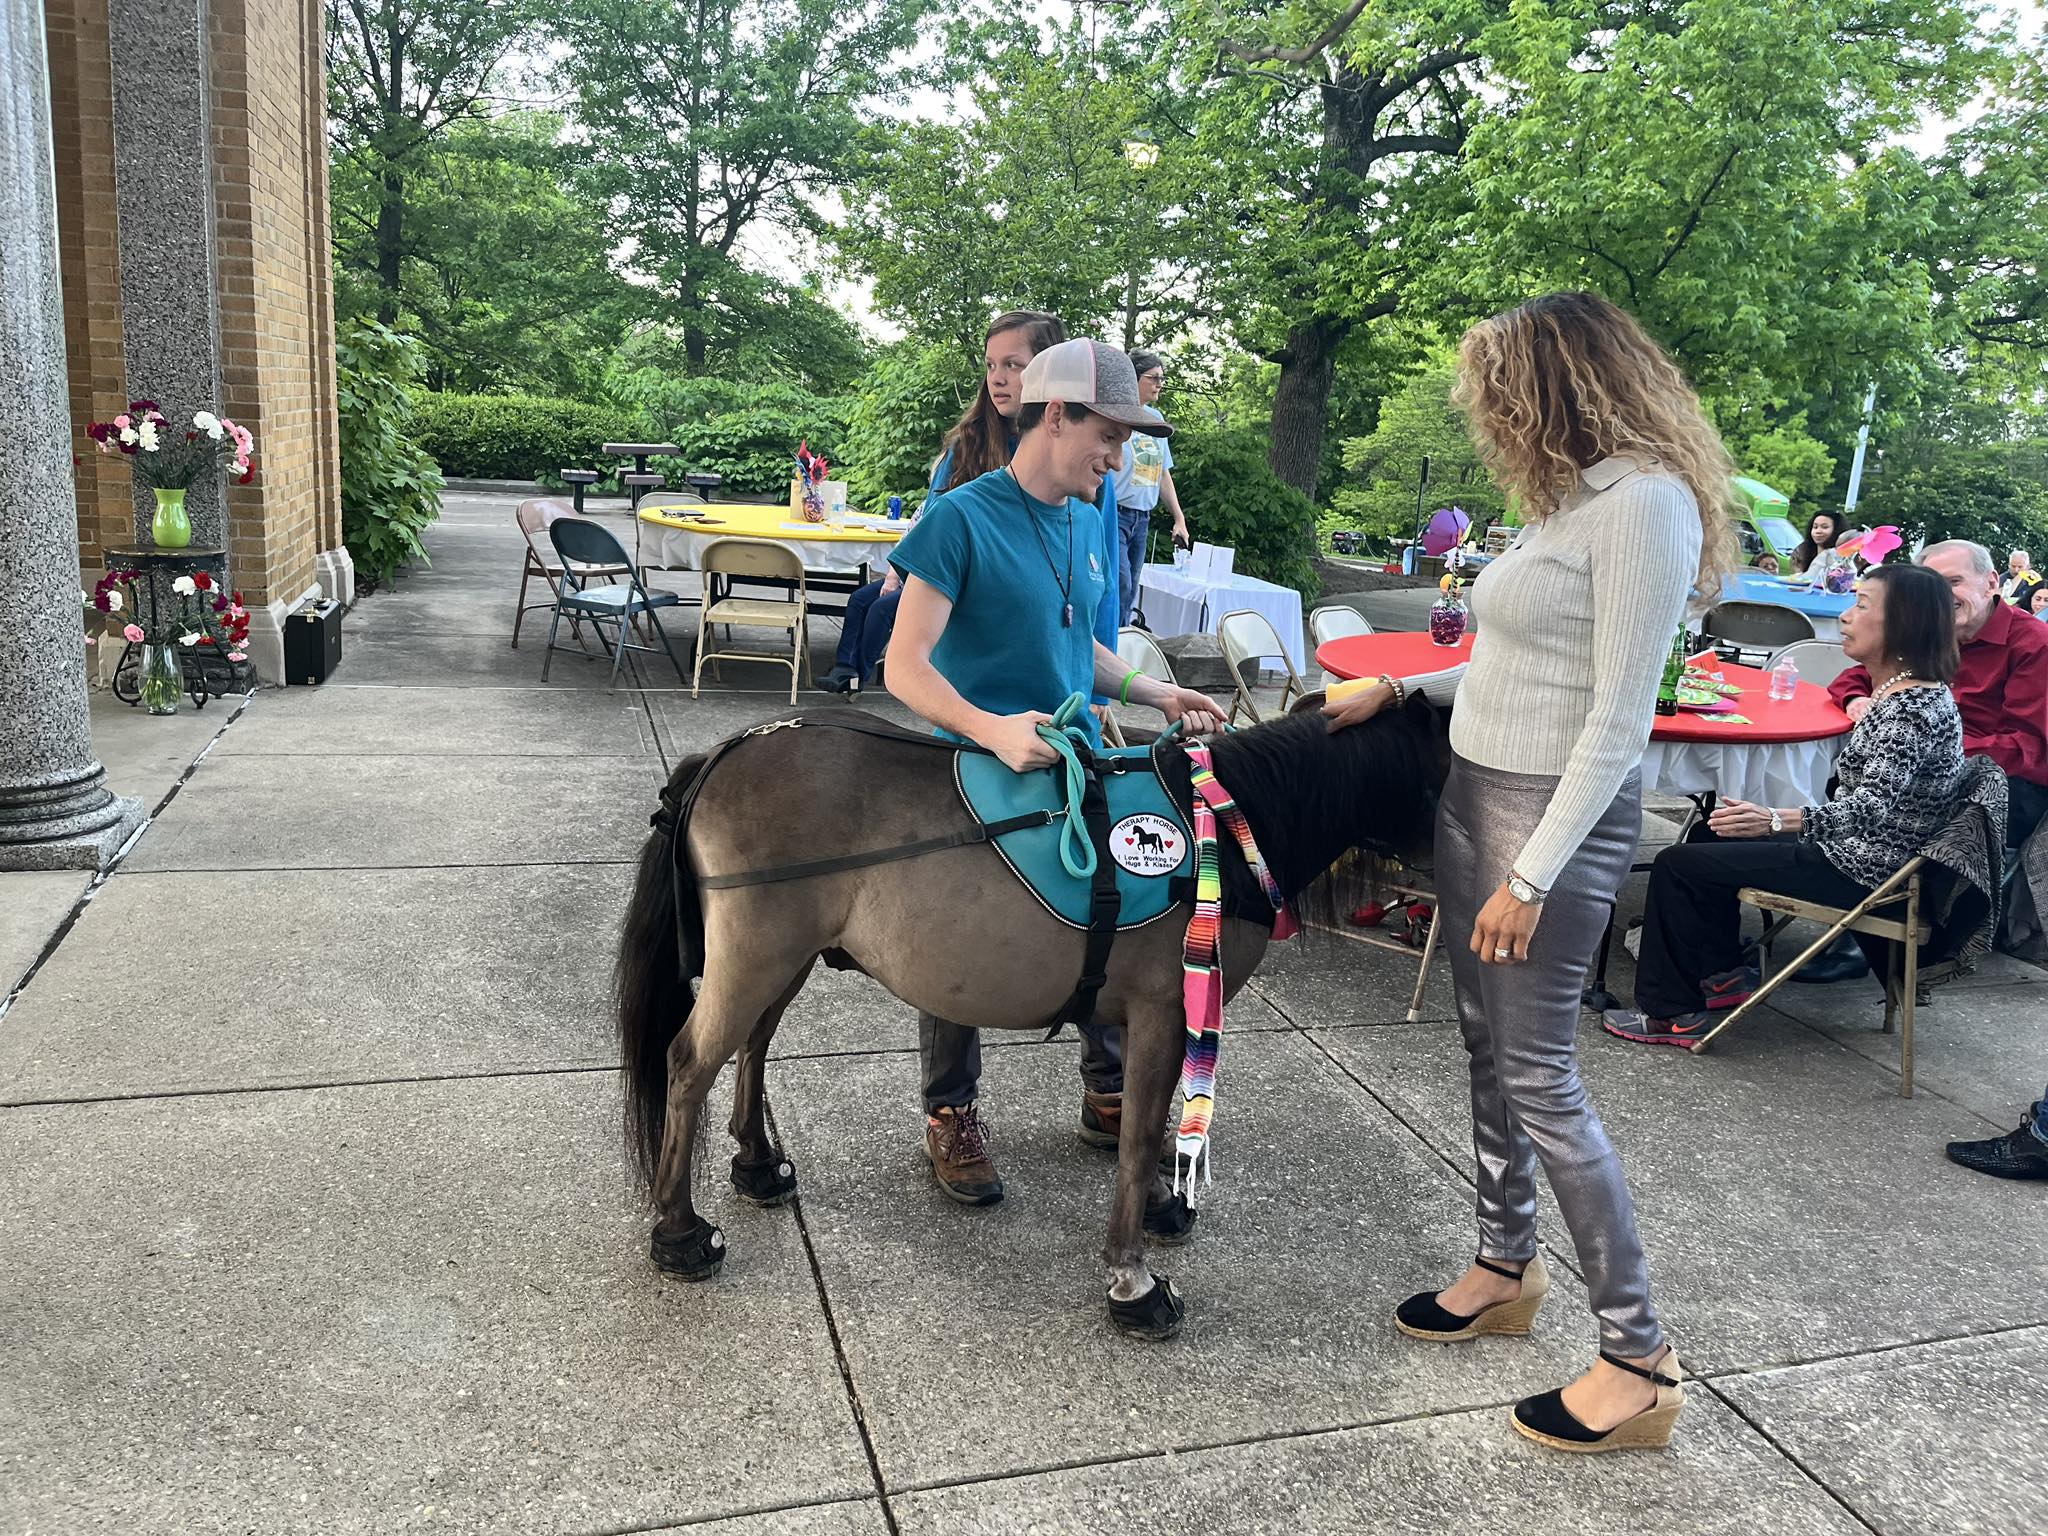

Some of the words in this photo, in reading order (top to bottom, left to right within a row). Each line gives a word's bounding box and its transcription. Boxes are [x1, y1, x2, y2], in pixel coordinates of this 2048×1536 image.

[1118, 817, 1150, 832] THERAPY
[1153, 818, 1178, 835] HORSE
[1143, 855, 1167, 863] Working
